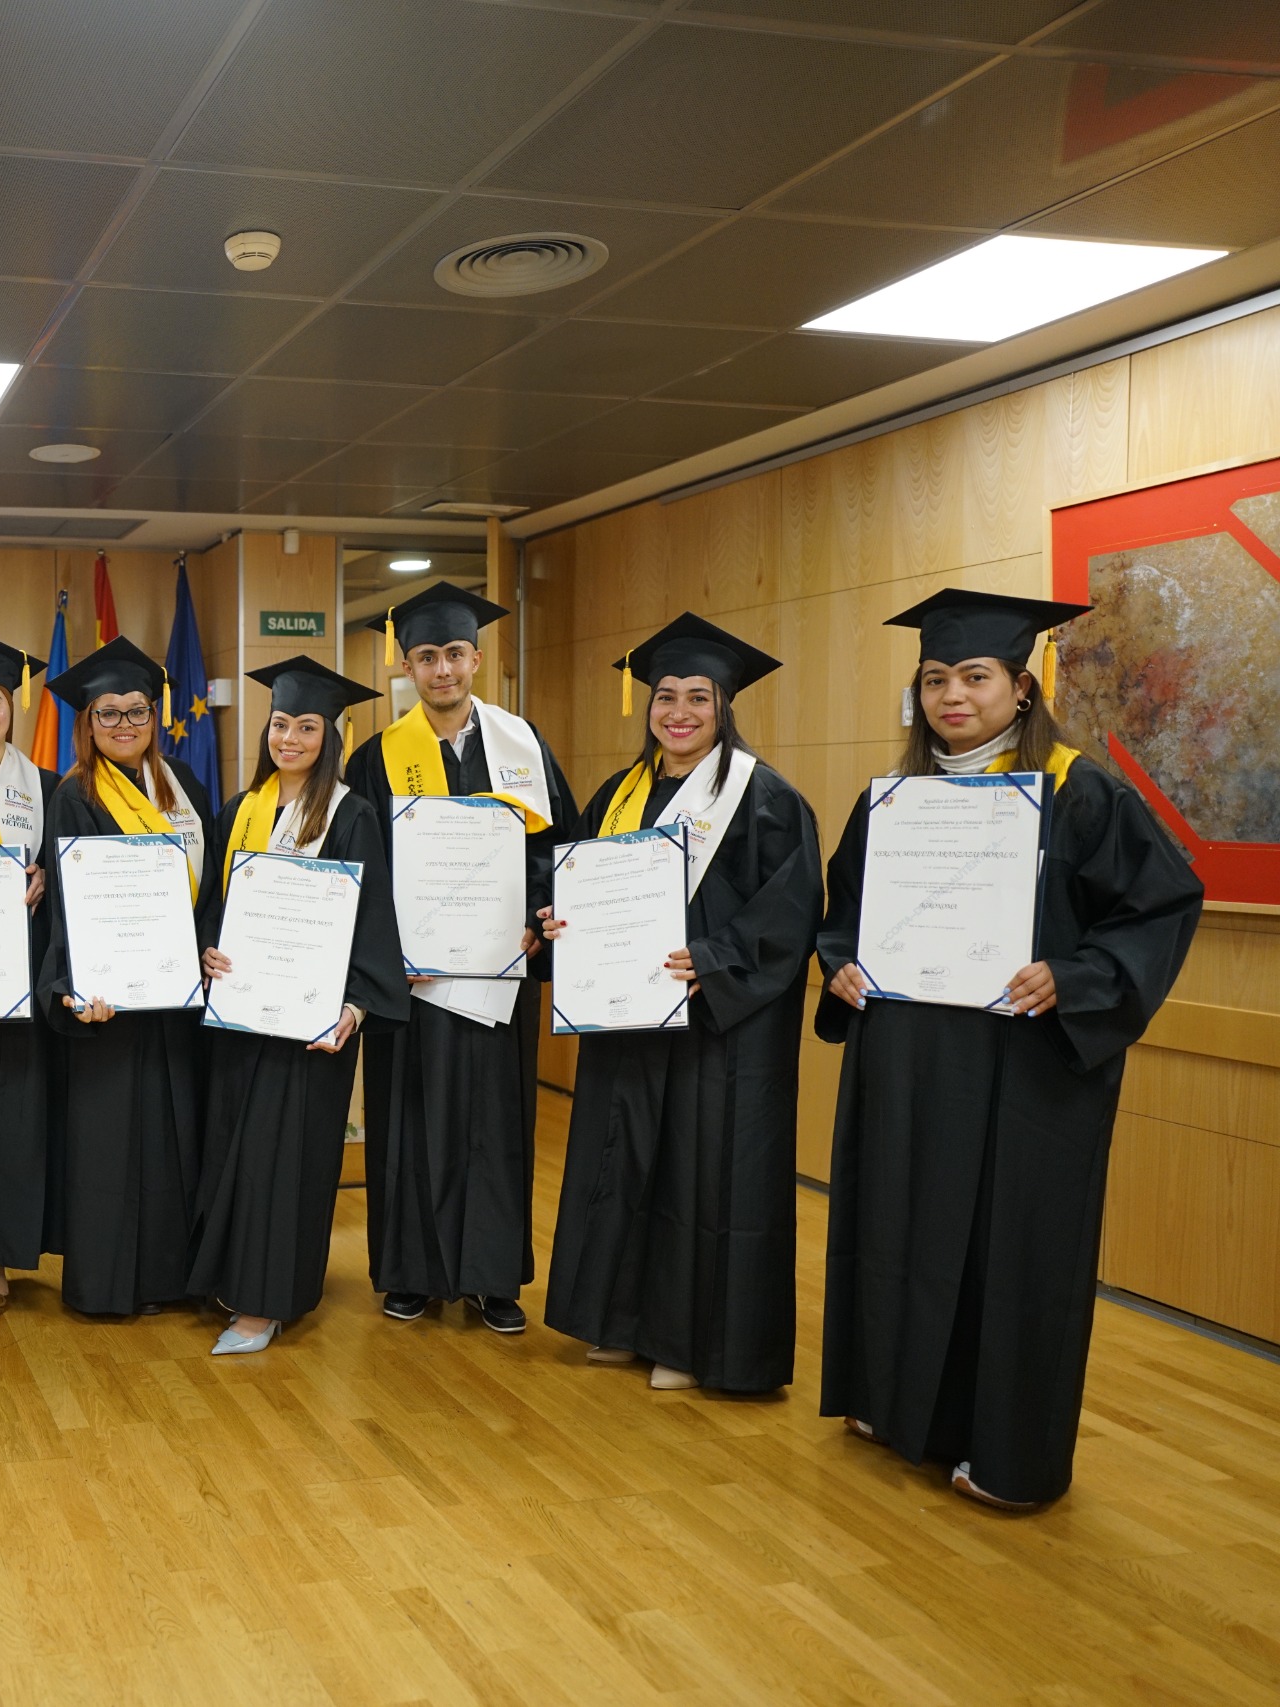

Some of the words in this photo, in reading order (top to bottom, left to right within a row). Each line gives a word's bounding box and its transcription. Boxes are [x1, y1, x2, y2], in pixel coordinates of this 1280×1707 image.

[268, 617, 317, 631] SALIDA
[499, 768, 530, 783] UNAD
[994, 790, 1019, 801] UNAD
[1, 817, 34, 831] VICTORIA
[6, 812, 30, 824] CAROL
